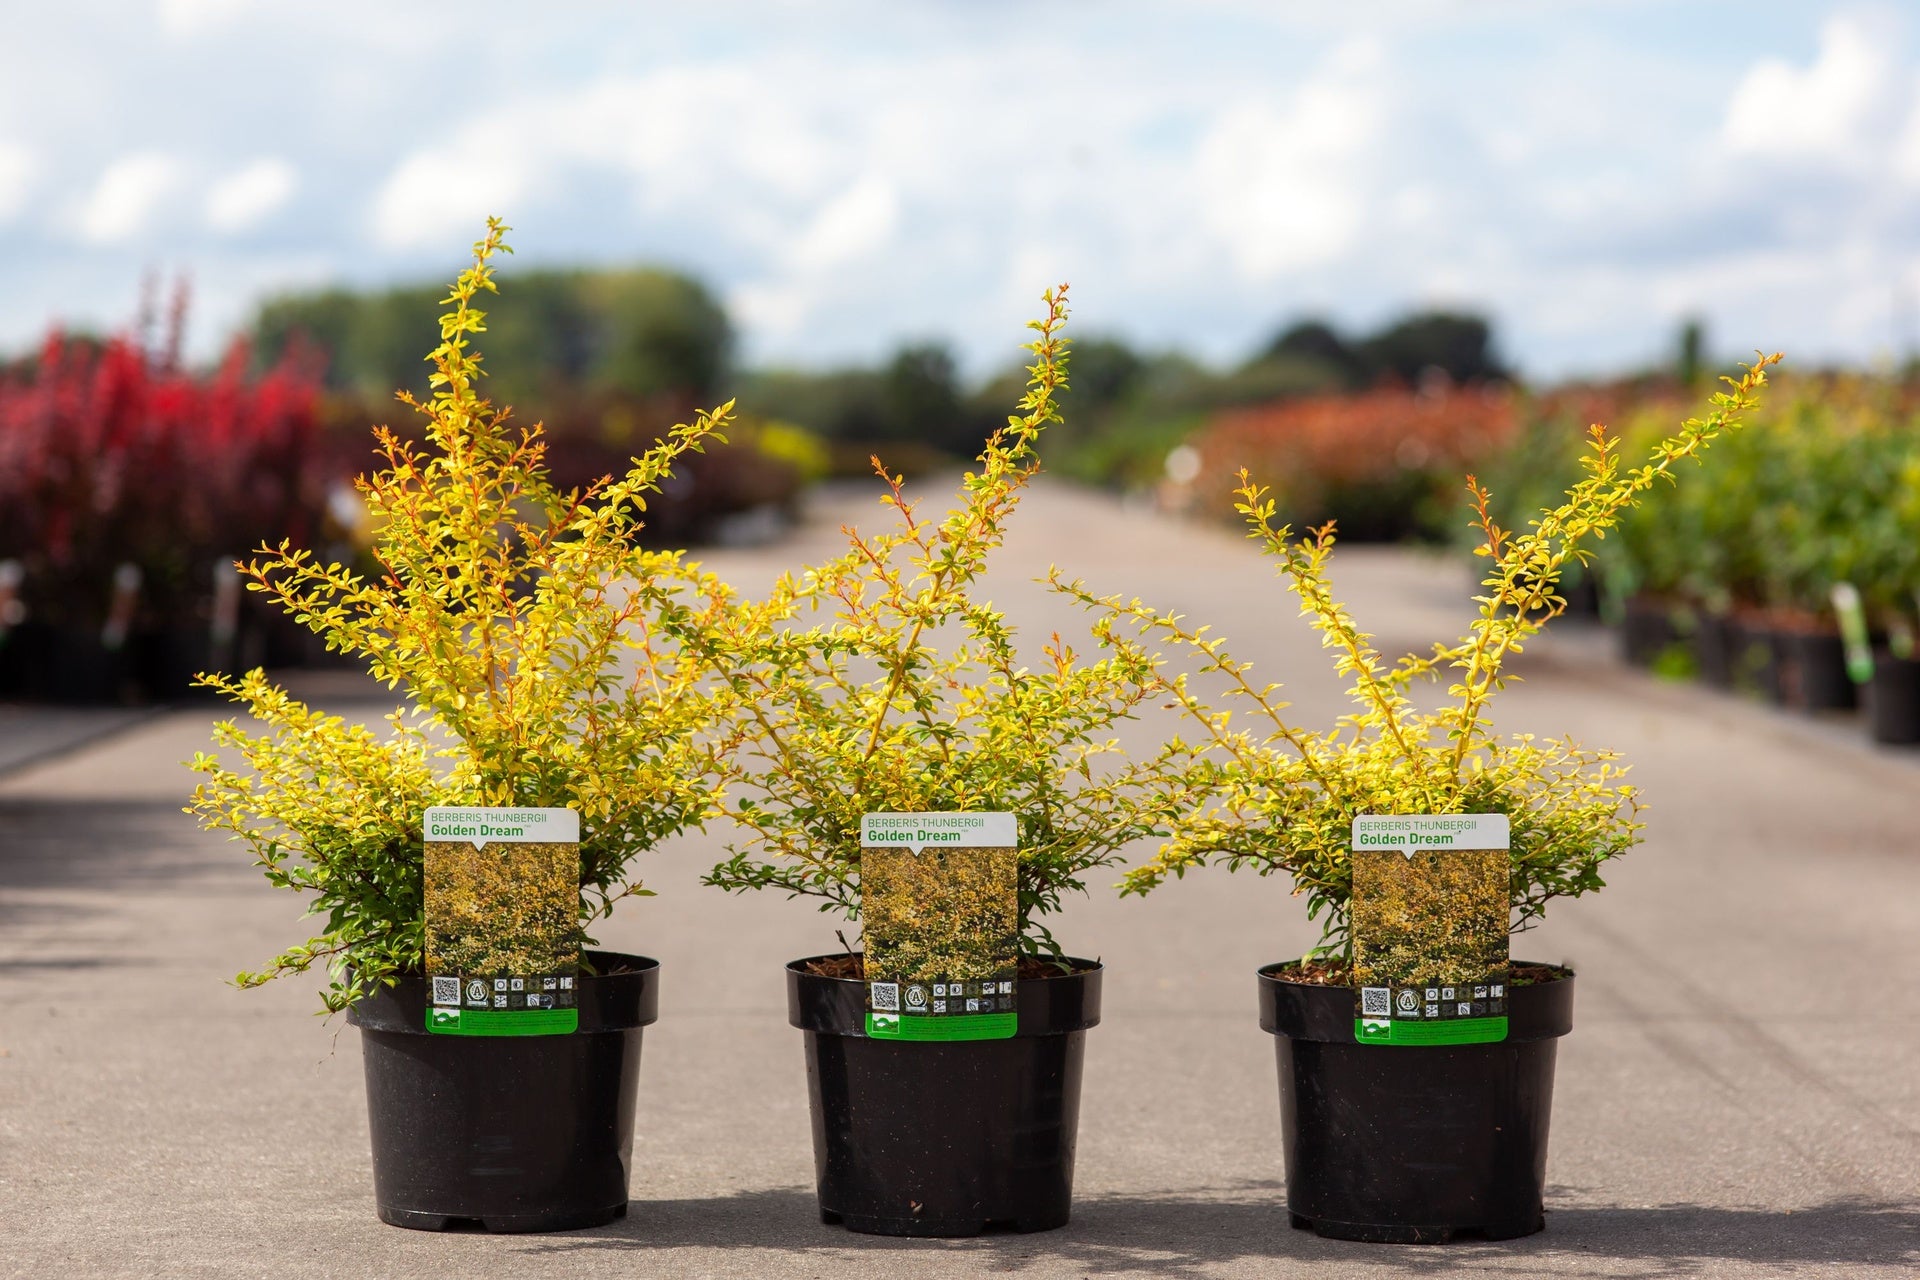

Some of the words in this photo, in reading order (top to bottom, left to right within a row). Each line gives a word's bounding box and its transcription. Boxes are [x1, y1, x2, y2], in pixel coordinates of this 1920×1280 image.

[431, 812, 482, 823] BERBERIS
[485, 813, 547, 823] THUNBERGII
[868, 818, 919, 828] BERBERIS
[922, 818, 984, 828] THUNBERGII
[431, 824, 476, 836] Golden
[480, 824, 524, 836] Dream
[1360, 821, 1411, 832] BERBERIS
[1414, 820, 1477, 831] THUNBERGII
[868, 830, 914, 842] Golden
[917, 829, 961, 842] Dream
[1360, 833, 1406, 845] Golden
[1409, 833, 1454, 845] Dream
